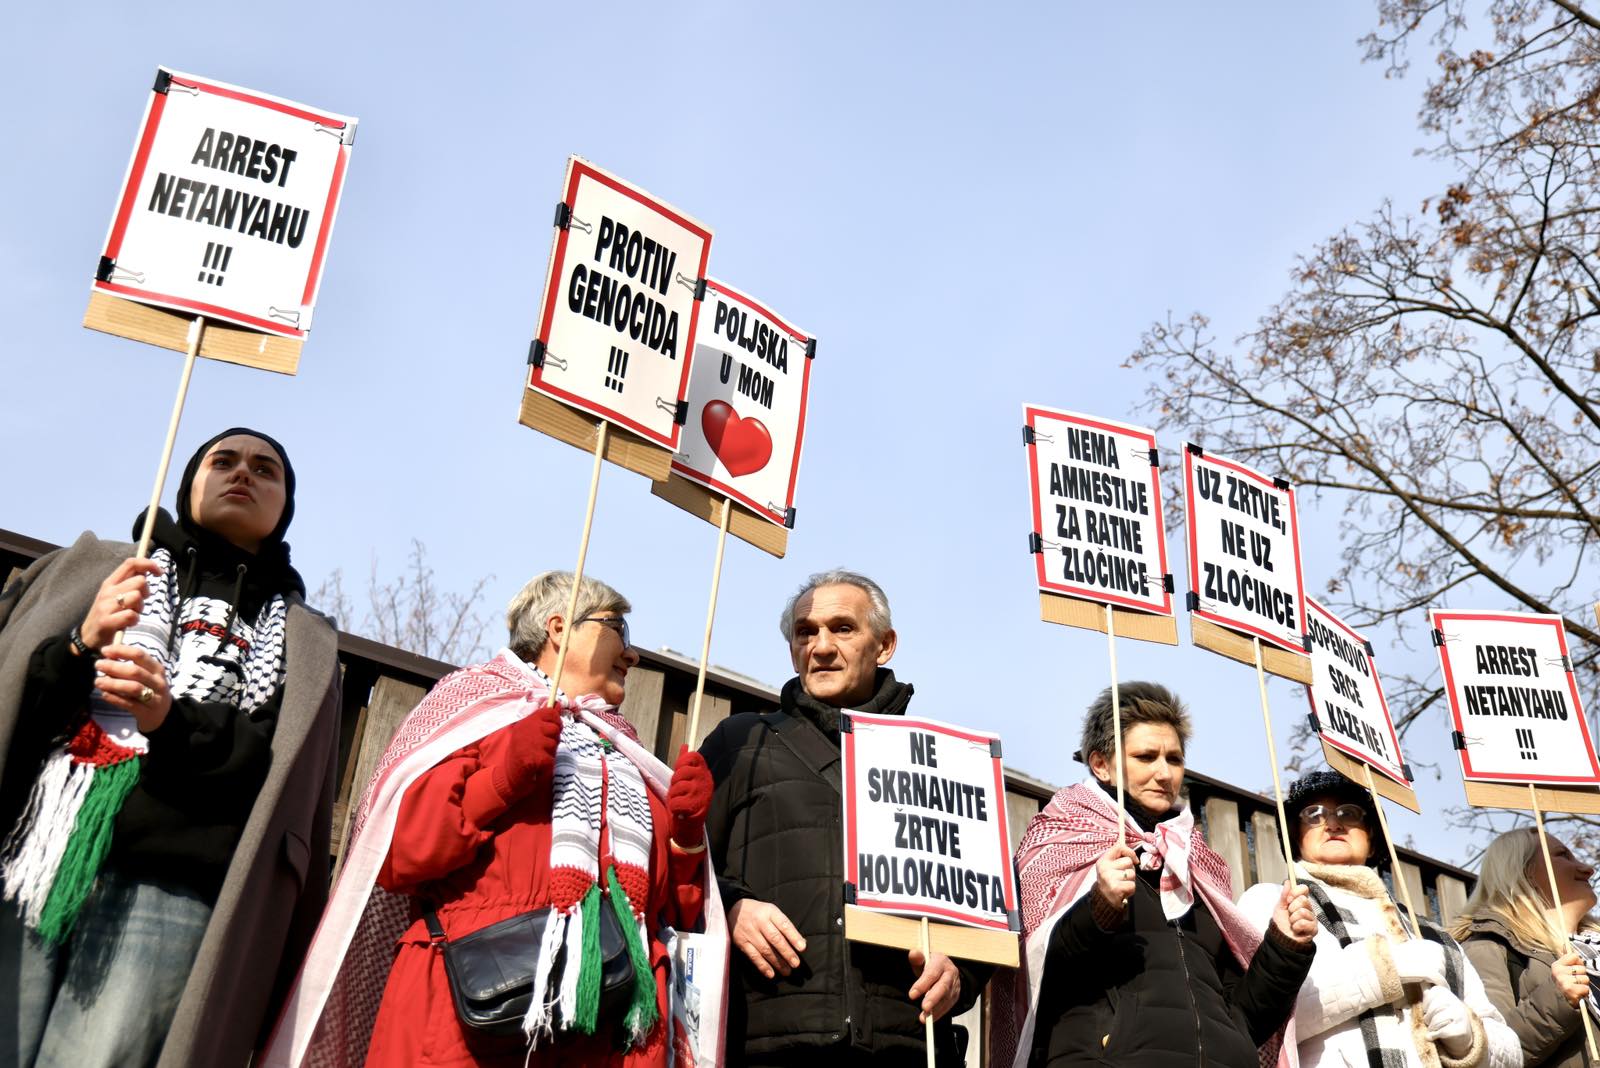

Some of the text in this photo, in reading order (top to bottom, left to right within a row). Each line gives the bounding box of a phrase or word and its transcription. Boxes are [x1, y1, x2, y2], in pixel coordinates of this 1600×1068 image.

[192, 128, 297, 187] ARREST
[148, 173, 309, 248] NETANYAHU
[198, 242, 232, 286] !!!
[595, 216, 676, 296] PROTIV
[568, 264, 678, 360] GENOCIDA
[714, 301, 787, 374] POLJSKA
[605, 346, 629, 393] !!!
[720, 353, 774, 409] U MOM
[1068, 427, 1119, 469] NEMA
[1050, 463, 1148, 515] AMNESTIJE
[1197, 465, 1286, 536] UZ ŽRTVE,
[1056, 504, 1143, 554] ZA RATNE
[1221, 519, 1273, 572] NE UZ
[1062, 546, 1149, 597] ZLOČINCE
[1204, 562, 1295, 629] ZLOČINCE
[1329, 665, 1363, 708] SRCE
[1476, 645, 1539, 677] ARREST
[1464, 686, 1567, 721] NETANYAHU
[910, 732, 937, 768] NE
[1361, 720, 1383, 757] NE
[1516, 729, 1537, 760] !!!
[868, 768, 987, 821] SKRNAVITE
[894, 808, 961, 859] ŽRTVE
[858, 854, 1007, 914] HOLOKAUSTA
